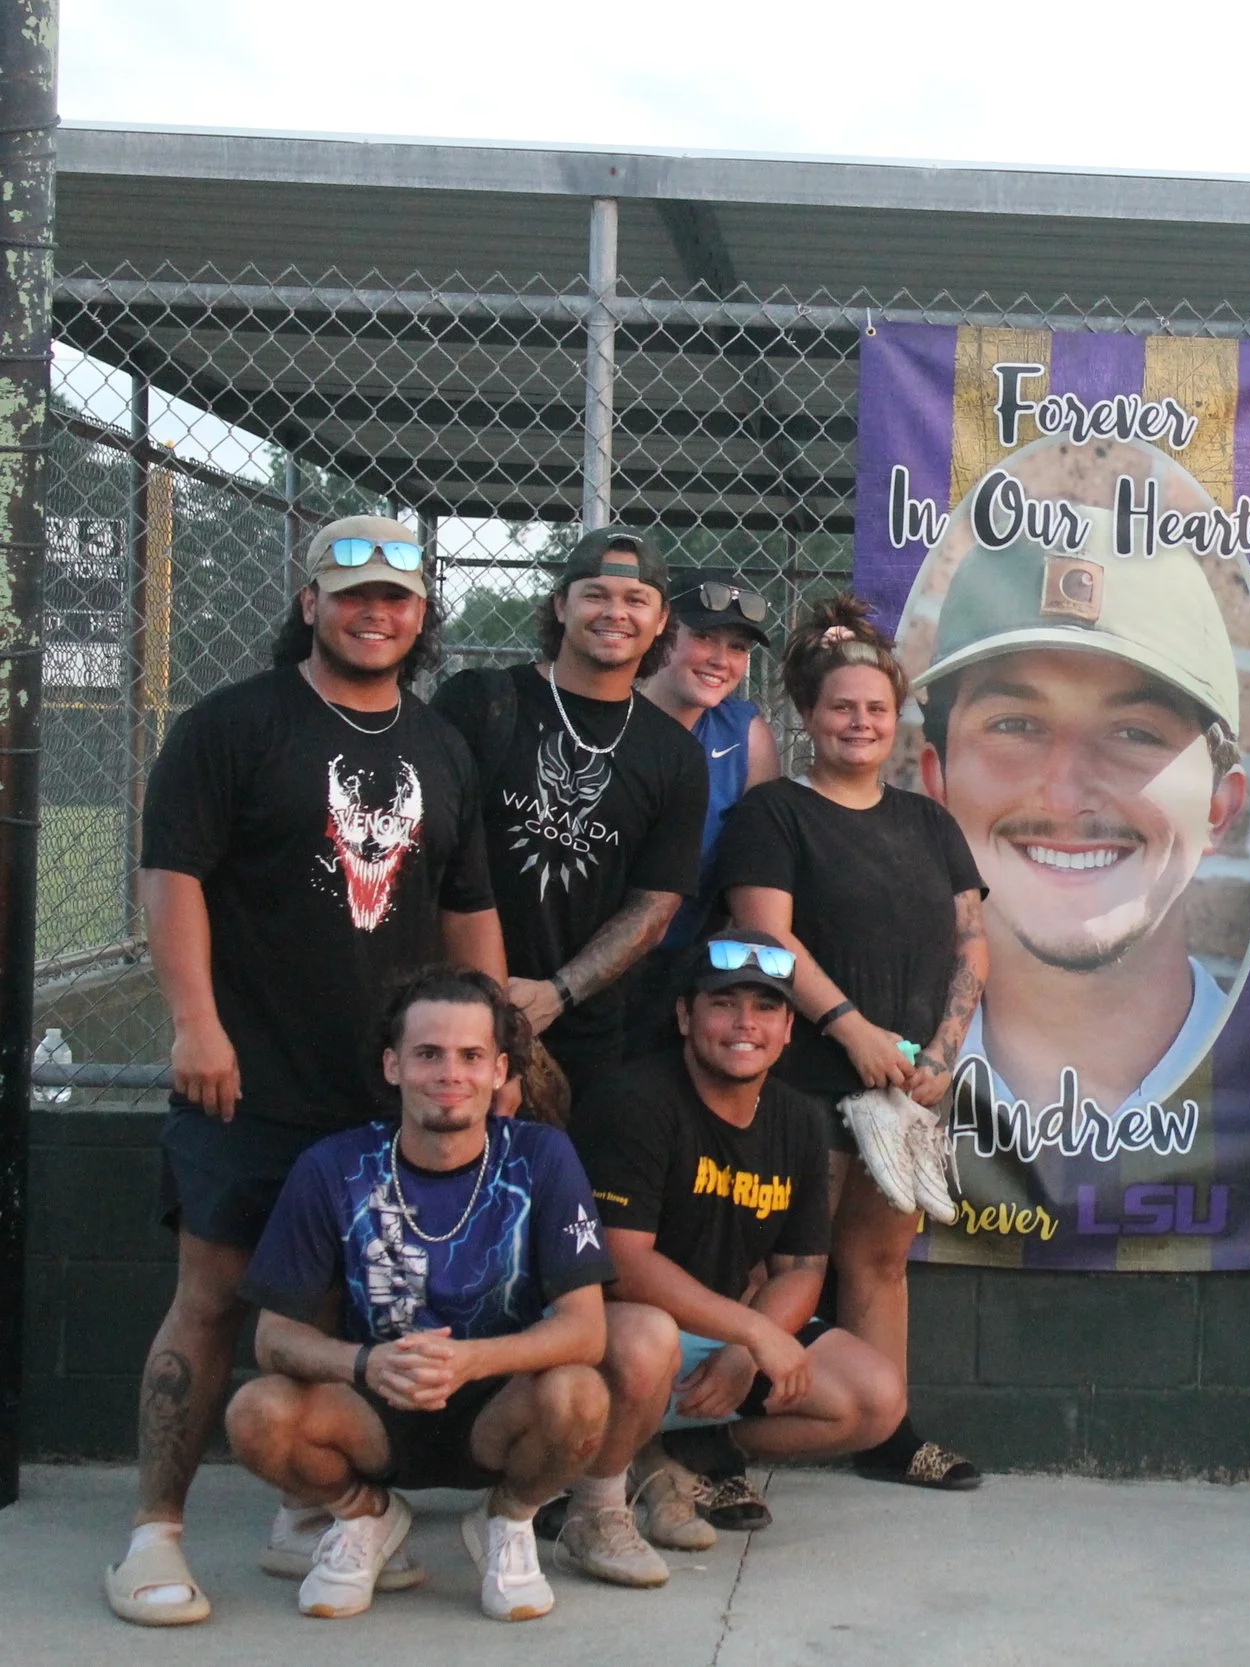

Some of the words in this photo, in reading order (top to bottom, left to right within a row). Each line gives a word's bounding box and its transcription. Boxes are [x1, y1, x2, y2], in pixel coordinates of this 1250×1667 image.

[993, 362, 1198, 450] Forever
[888, 465, 949, 549] In
[970, 468, 1091, 552] Our
[335, 803, 413, 846] VENOM
[503, 789, 618, 845] WAKANDA
[946, 1053, 1199, 1163] Andrew
[1076, 1184, 1229, 1236] LSU
